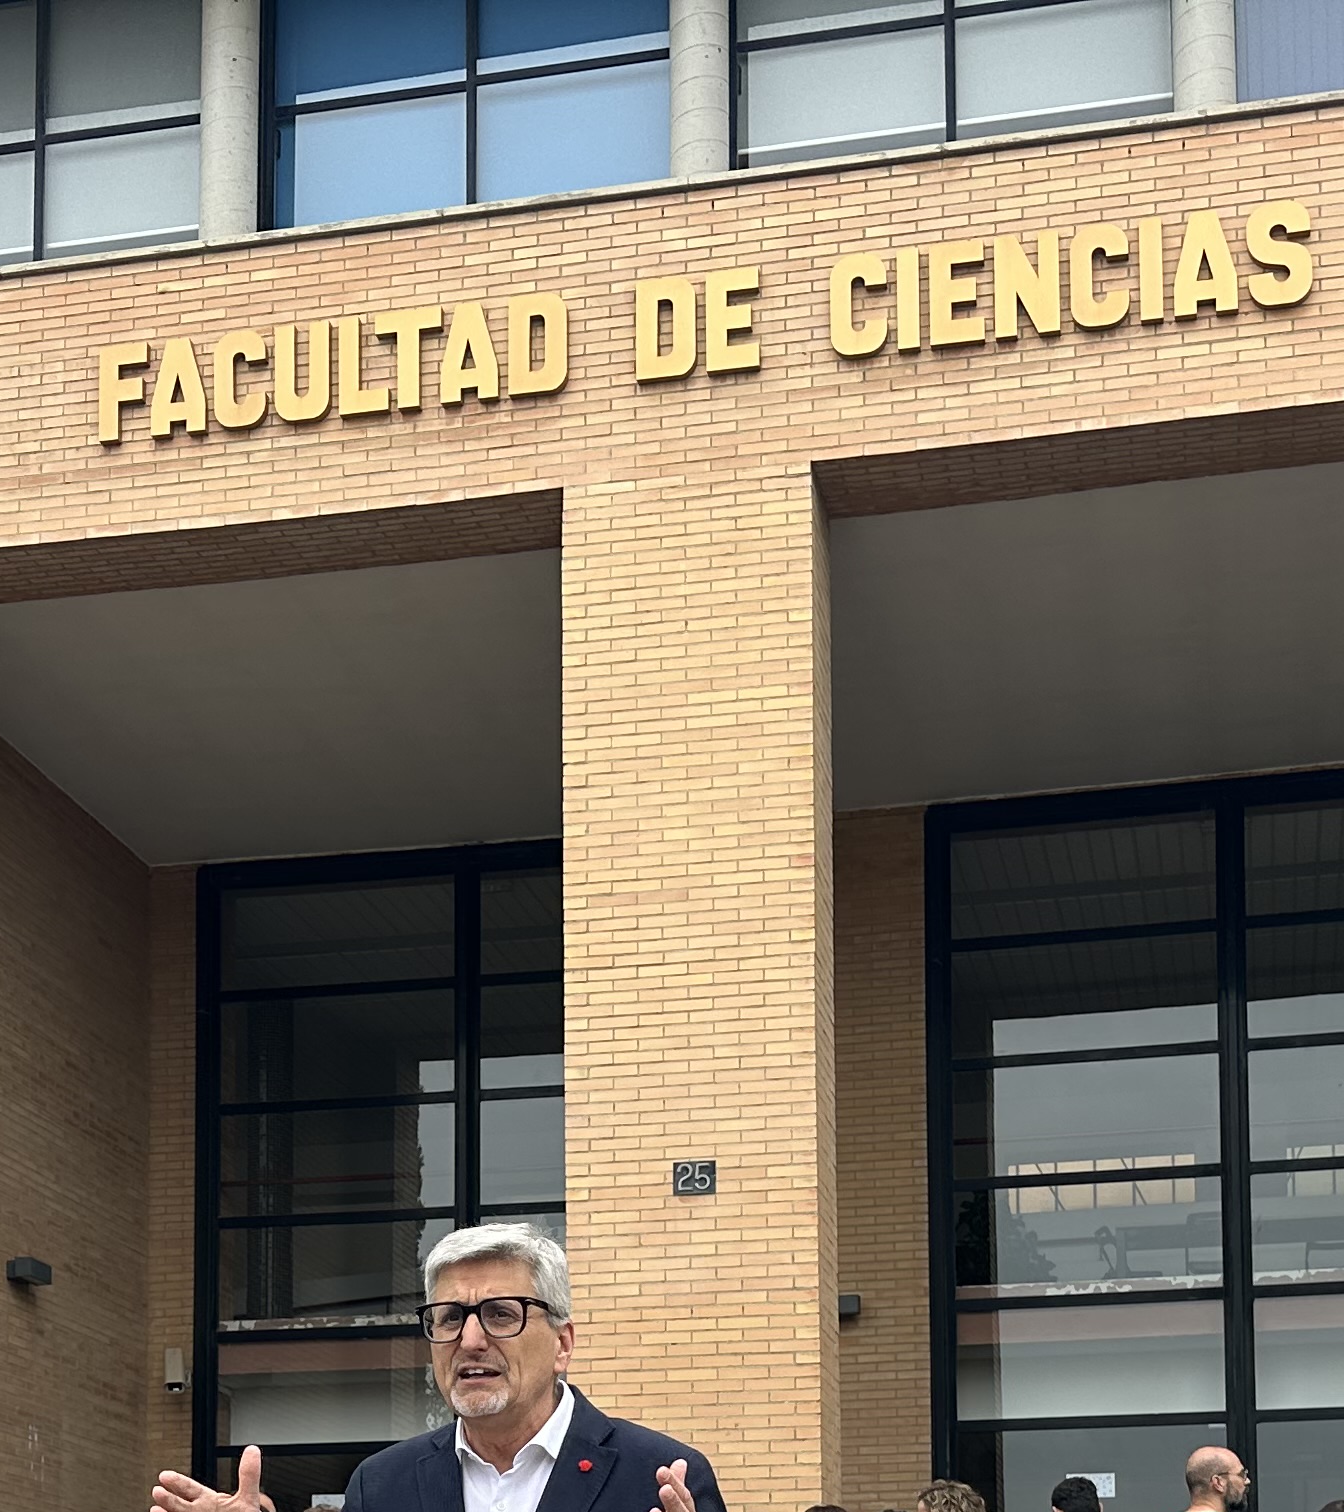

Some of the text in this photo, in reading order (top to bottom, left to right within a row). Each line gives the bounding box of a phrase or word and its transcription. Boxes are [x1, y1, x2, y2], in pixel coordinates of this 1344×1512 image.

[97, 291, 569, 446] FACULTAD
[635, 265, 762, 384] DE
[829, 199, 1315, 358] CIENCIAS
[676, 1163, 711, 1190] 25
